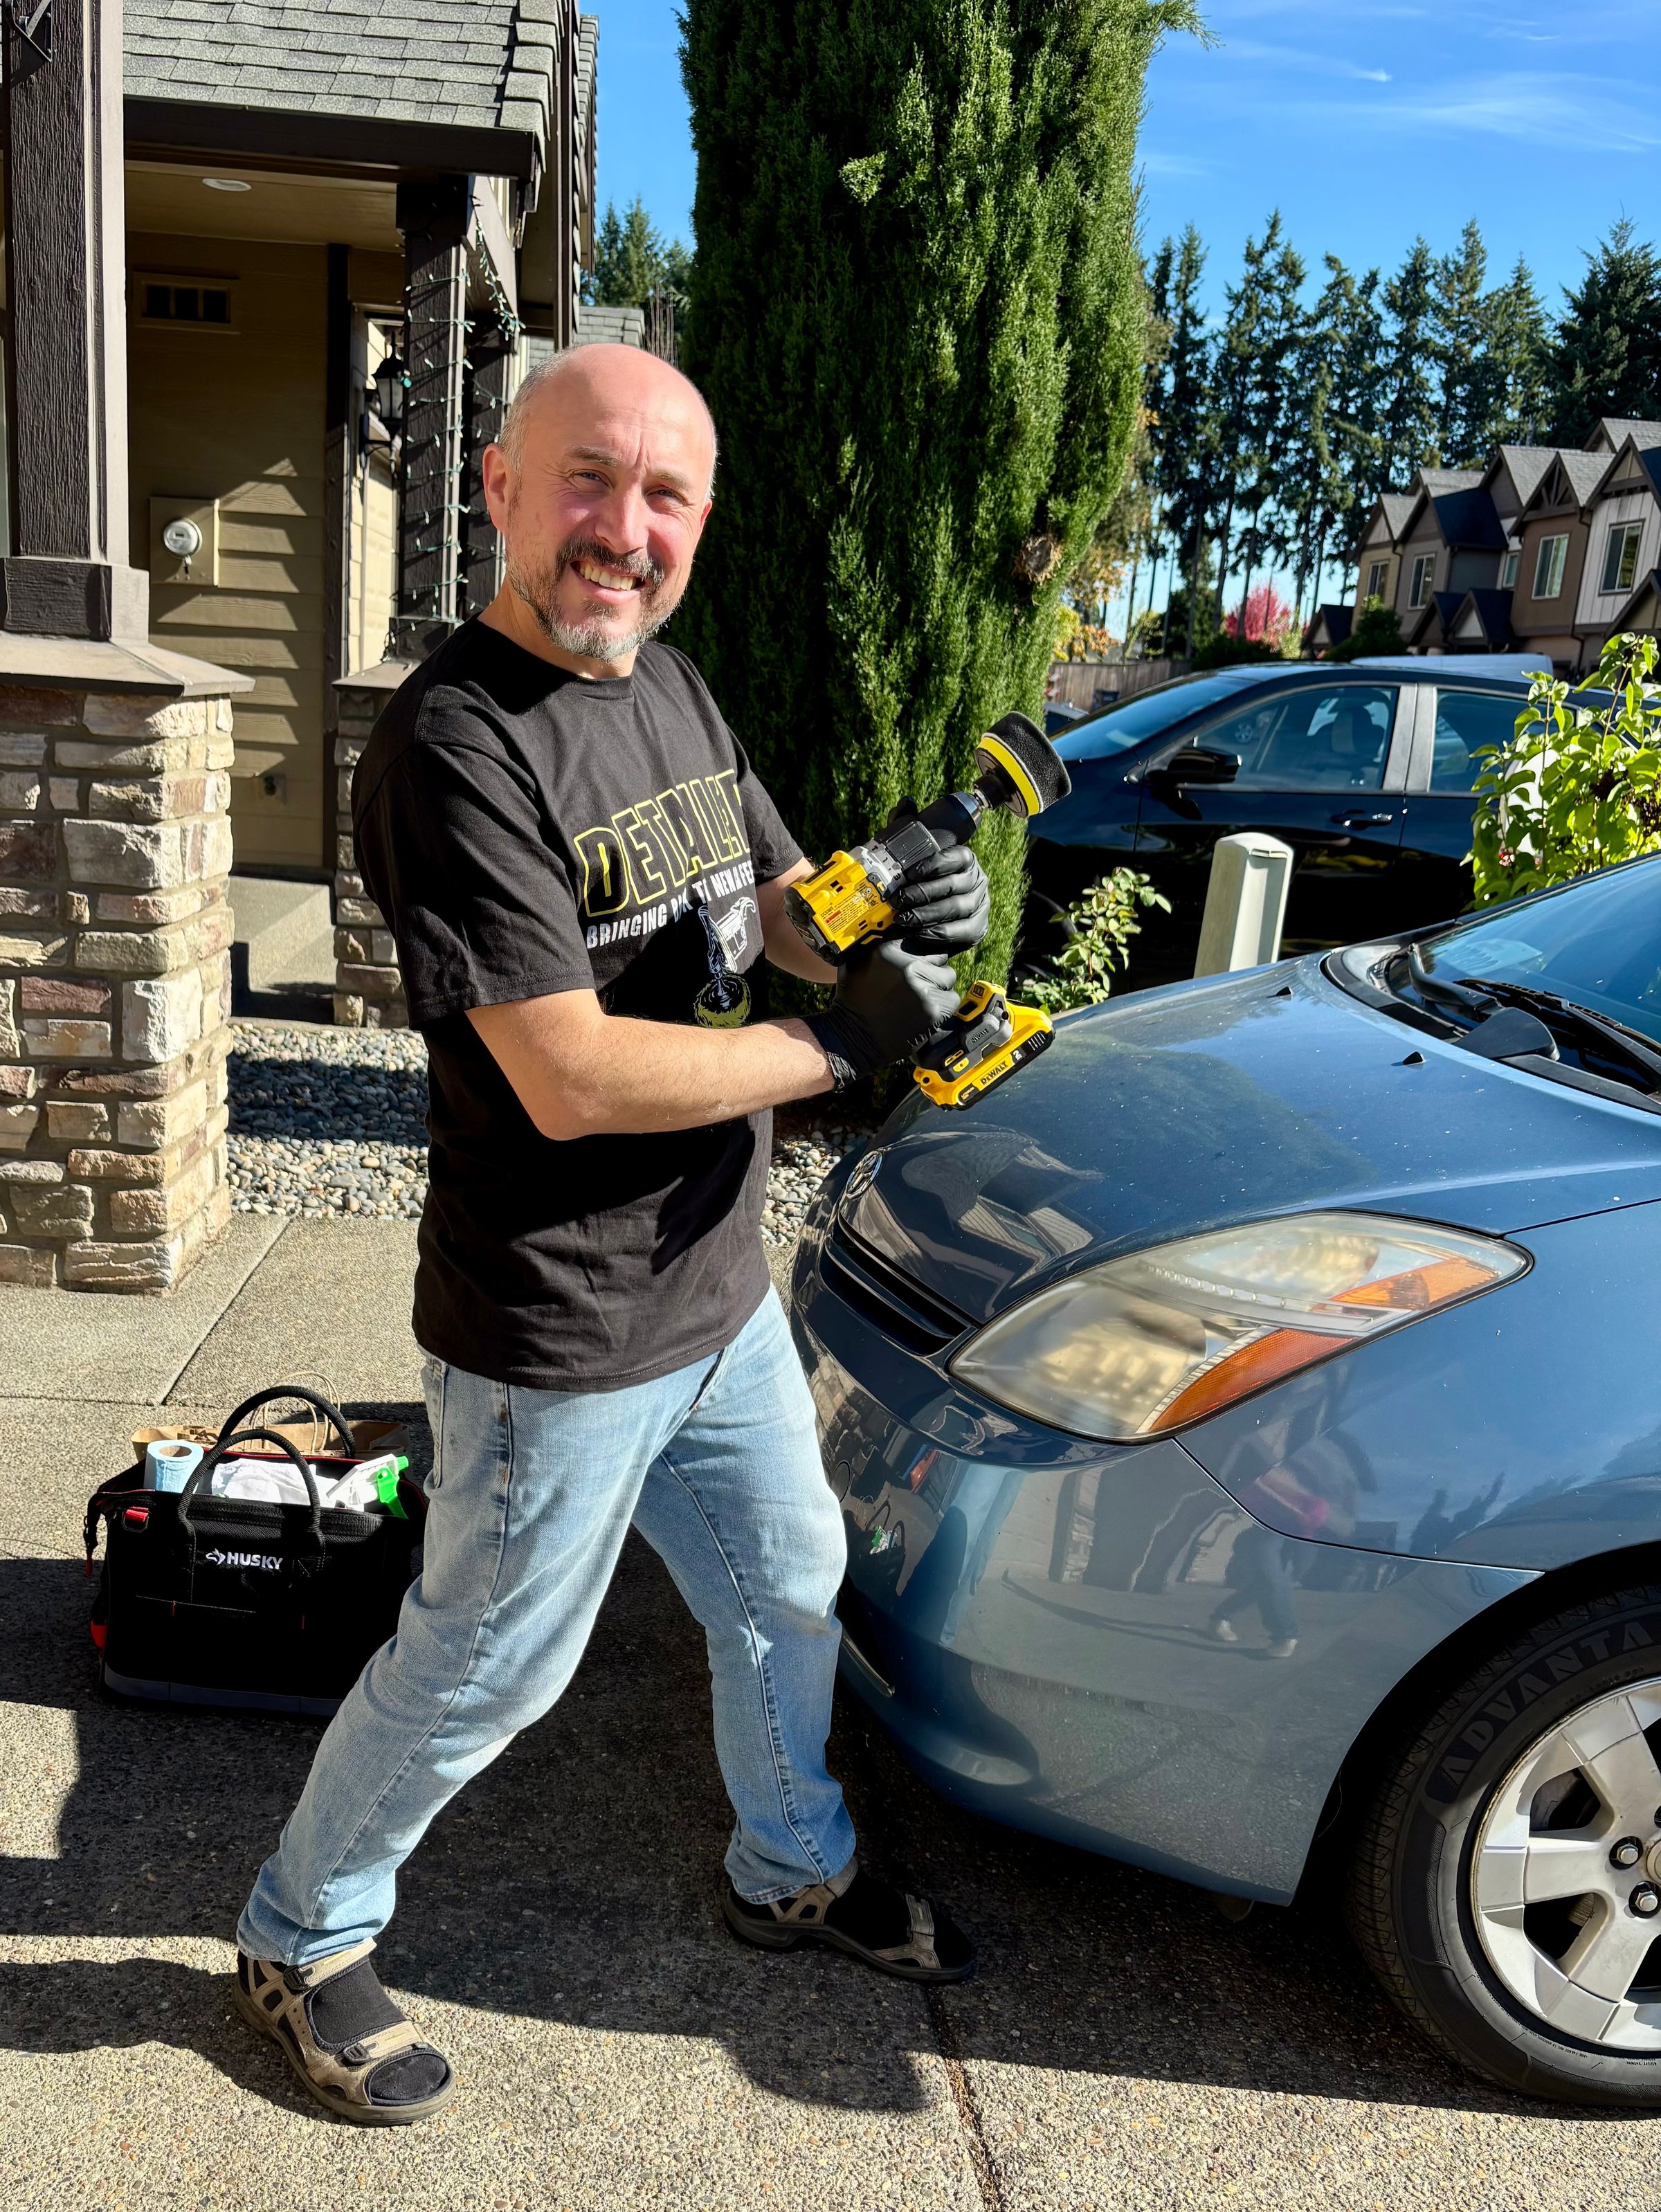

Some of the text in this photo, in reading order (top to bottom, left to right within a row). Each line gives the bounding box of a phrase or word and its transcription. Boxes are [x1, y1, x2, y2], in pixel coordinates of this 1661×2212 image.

[586, 903, 667, 949] BRINGING
[1013, 1049, 1022, 1060] 2
[227, 1551, 283, 1570] HUSKY
[1440, 1622, 1653, 1786] ADVANTA
